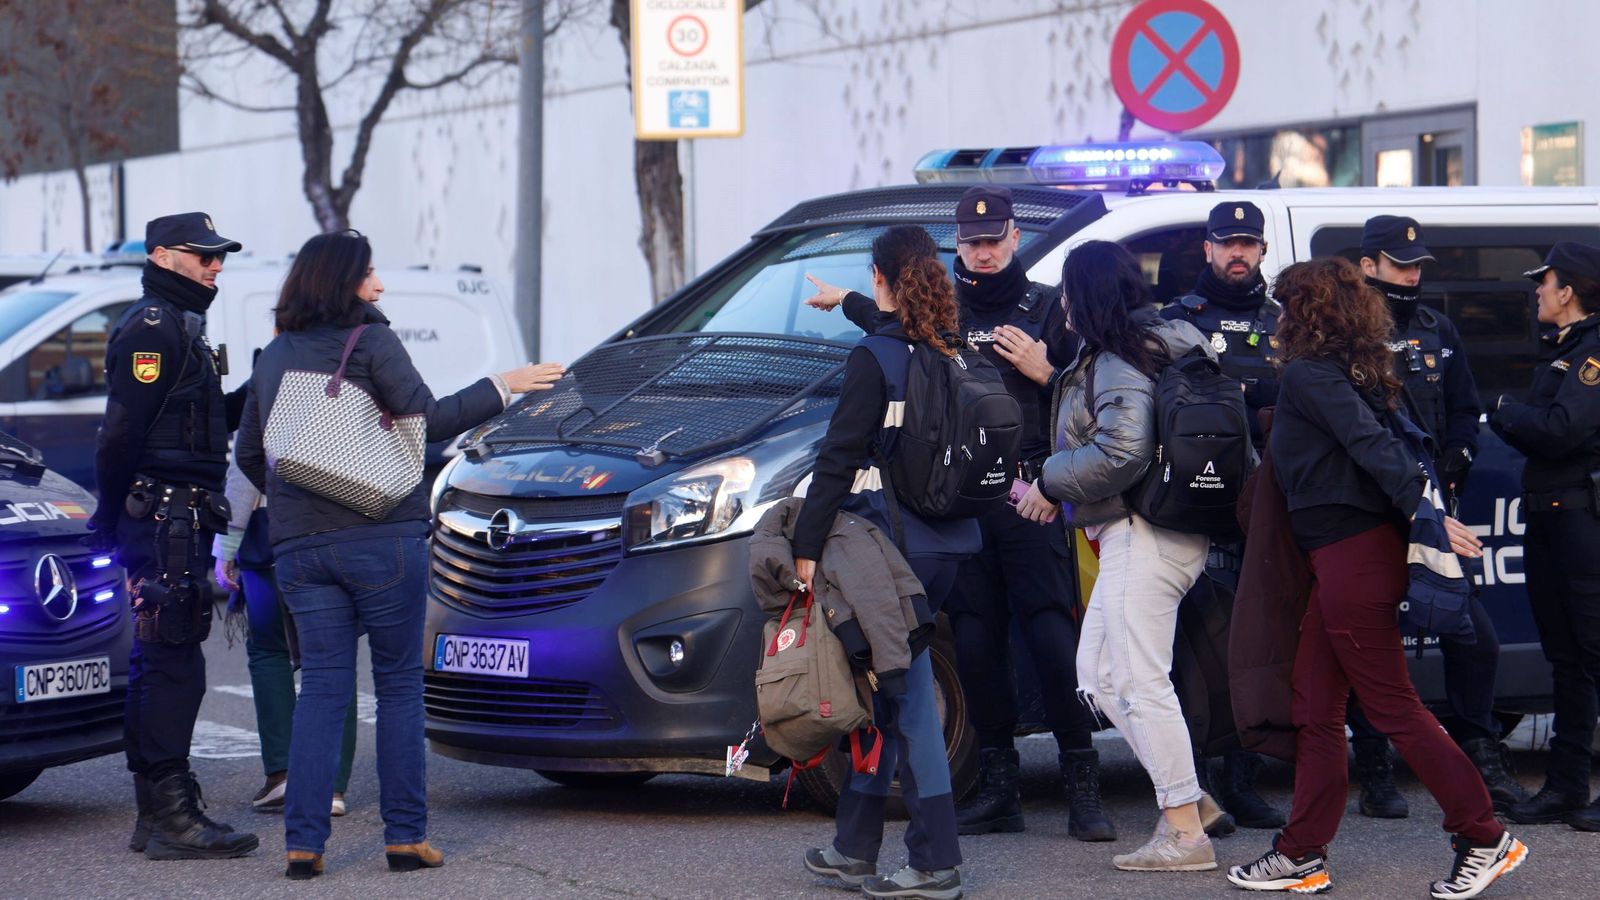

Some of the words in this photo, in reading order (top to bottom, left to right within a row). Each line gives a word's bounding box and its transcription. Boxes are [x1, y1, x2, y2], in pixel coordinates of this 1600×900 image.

[646, 0, 727, 9] CICLOCALLE
[676, 28, 699, 42] 30
[658, 61, 717, 71] CALZADA
[646, 76, 729, 86] COMPARTIDA
